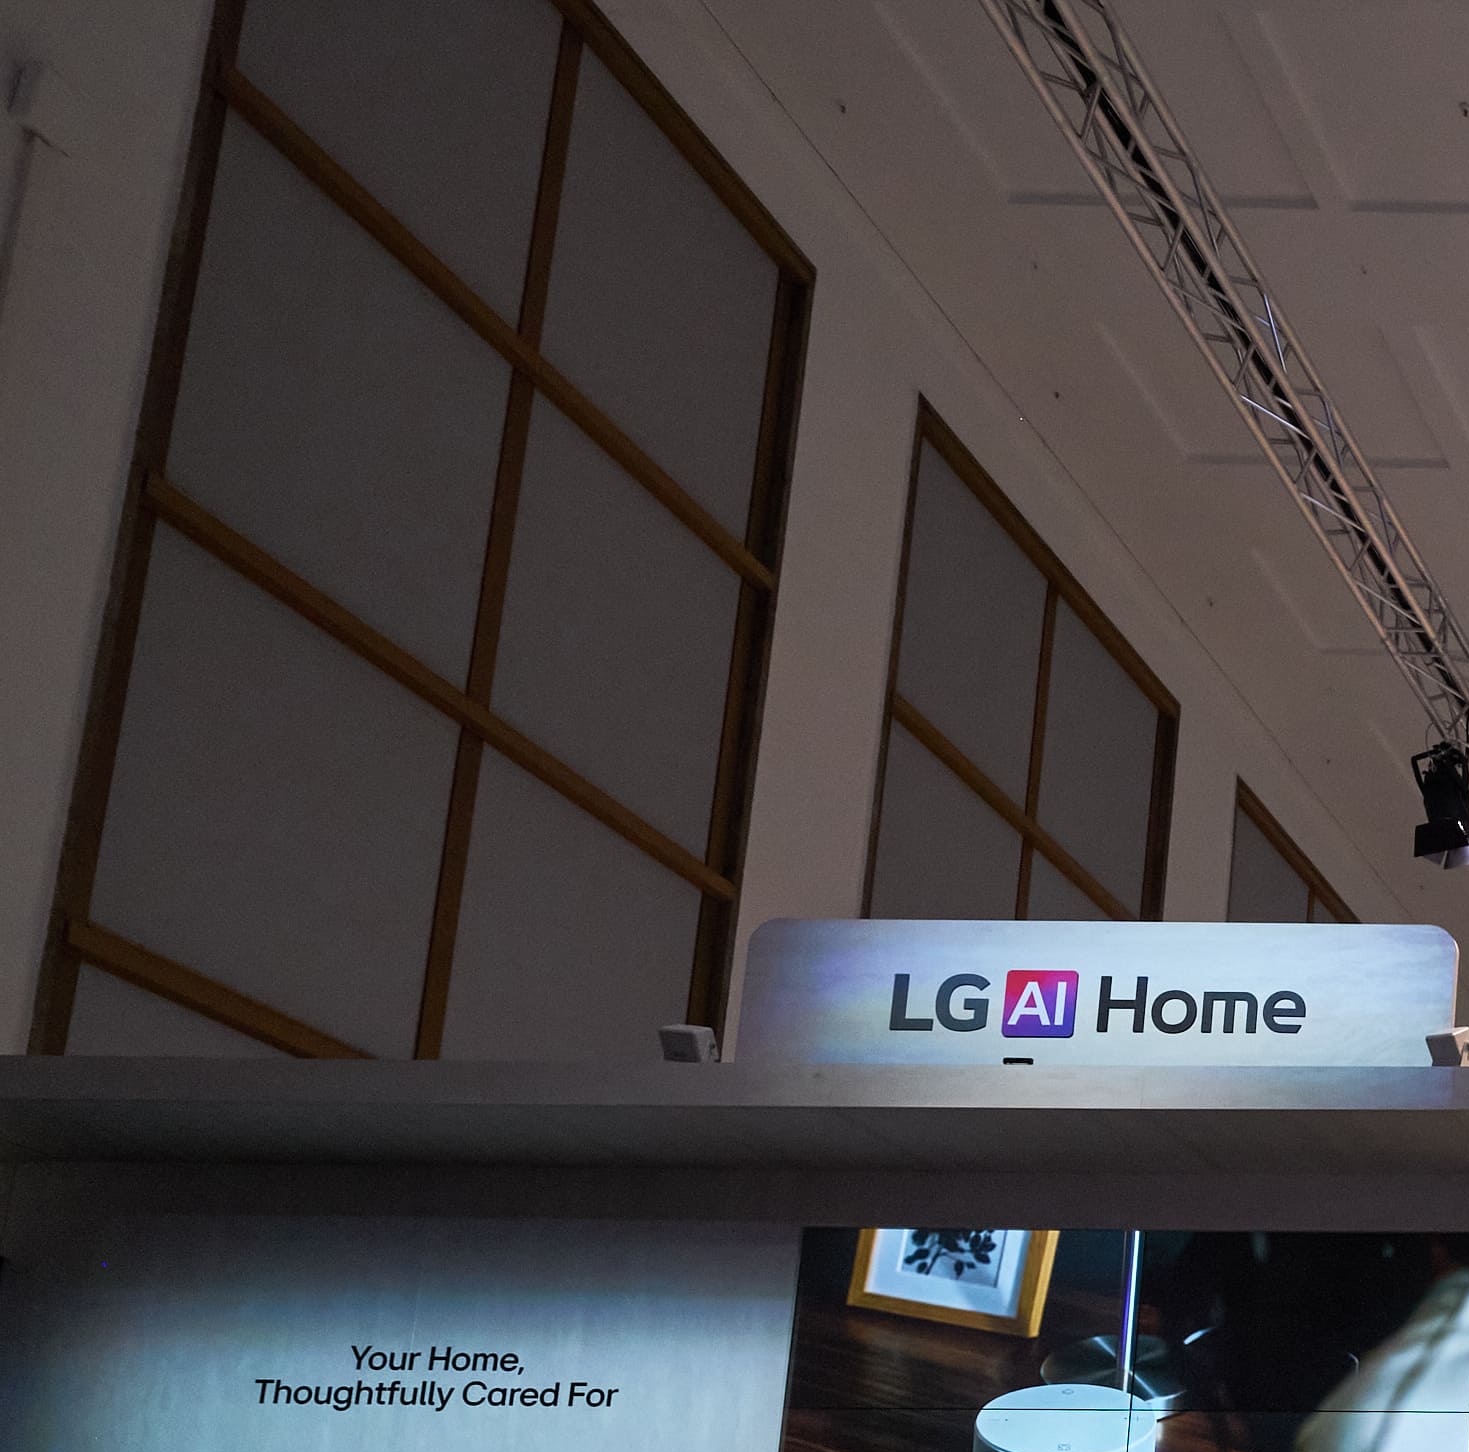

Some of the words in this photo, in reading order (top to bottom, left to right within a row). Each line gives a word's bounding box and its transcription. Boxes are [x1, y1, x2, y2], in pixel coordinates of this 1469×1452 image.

[889, 973, 991, 1032] LG
[1005, 979, 1069, 1029] AI
[1097, 976, 1307, 1034] Home
[351, 1345, 421, 1371] Your
[428, 1346, 525, 1375] Home,
[255, 1379, 454, 1411] Thoughtfully
[462, 1381, 560, 1407] Cared
[567, 1382, 619, 1407] For
